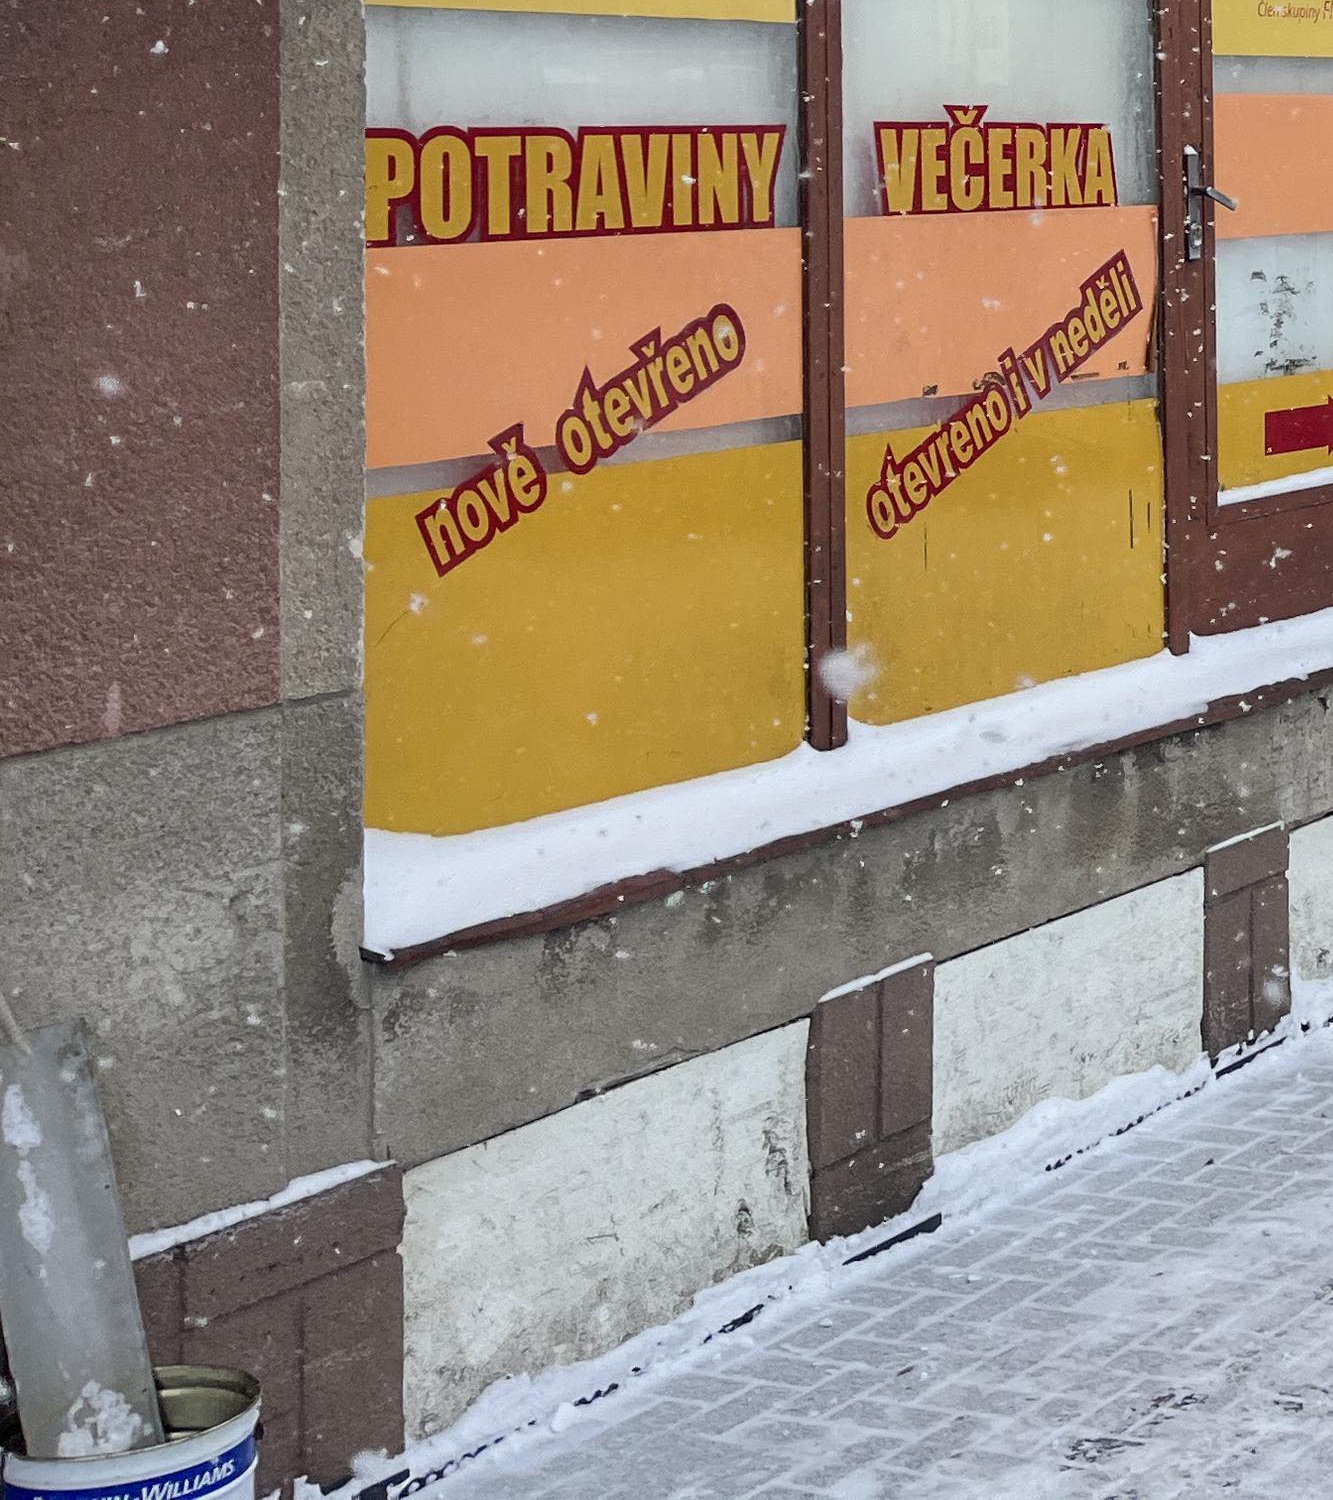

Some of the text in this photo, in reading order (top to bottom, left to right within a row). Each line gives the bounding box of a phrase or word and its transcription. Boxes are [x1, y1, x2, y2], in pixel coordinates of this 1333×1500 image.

[1282, 3, 1320, 24] skupiny
[362, 127, 783, 245] POTRAVINY
[876, 107, 1116, 214] VEČERKA
[419, 306, 742, 571] nově otevřeno
[870, 260, 1137, 535] otevřeno i v neděli
